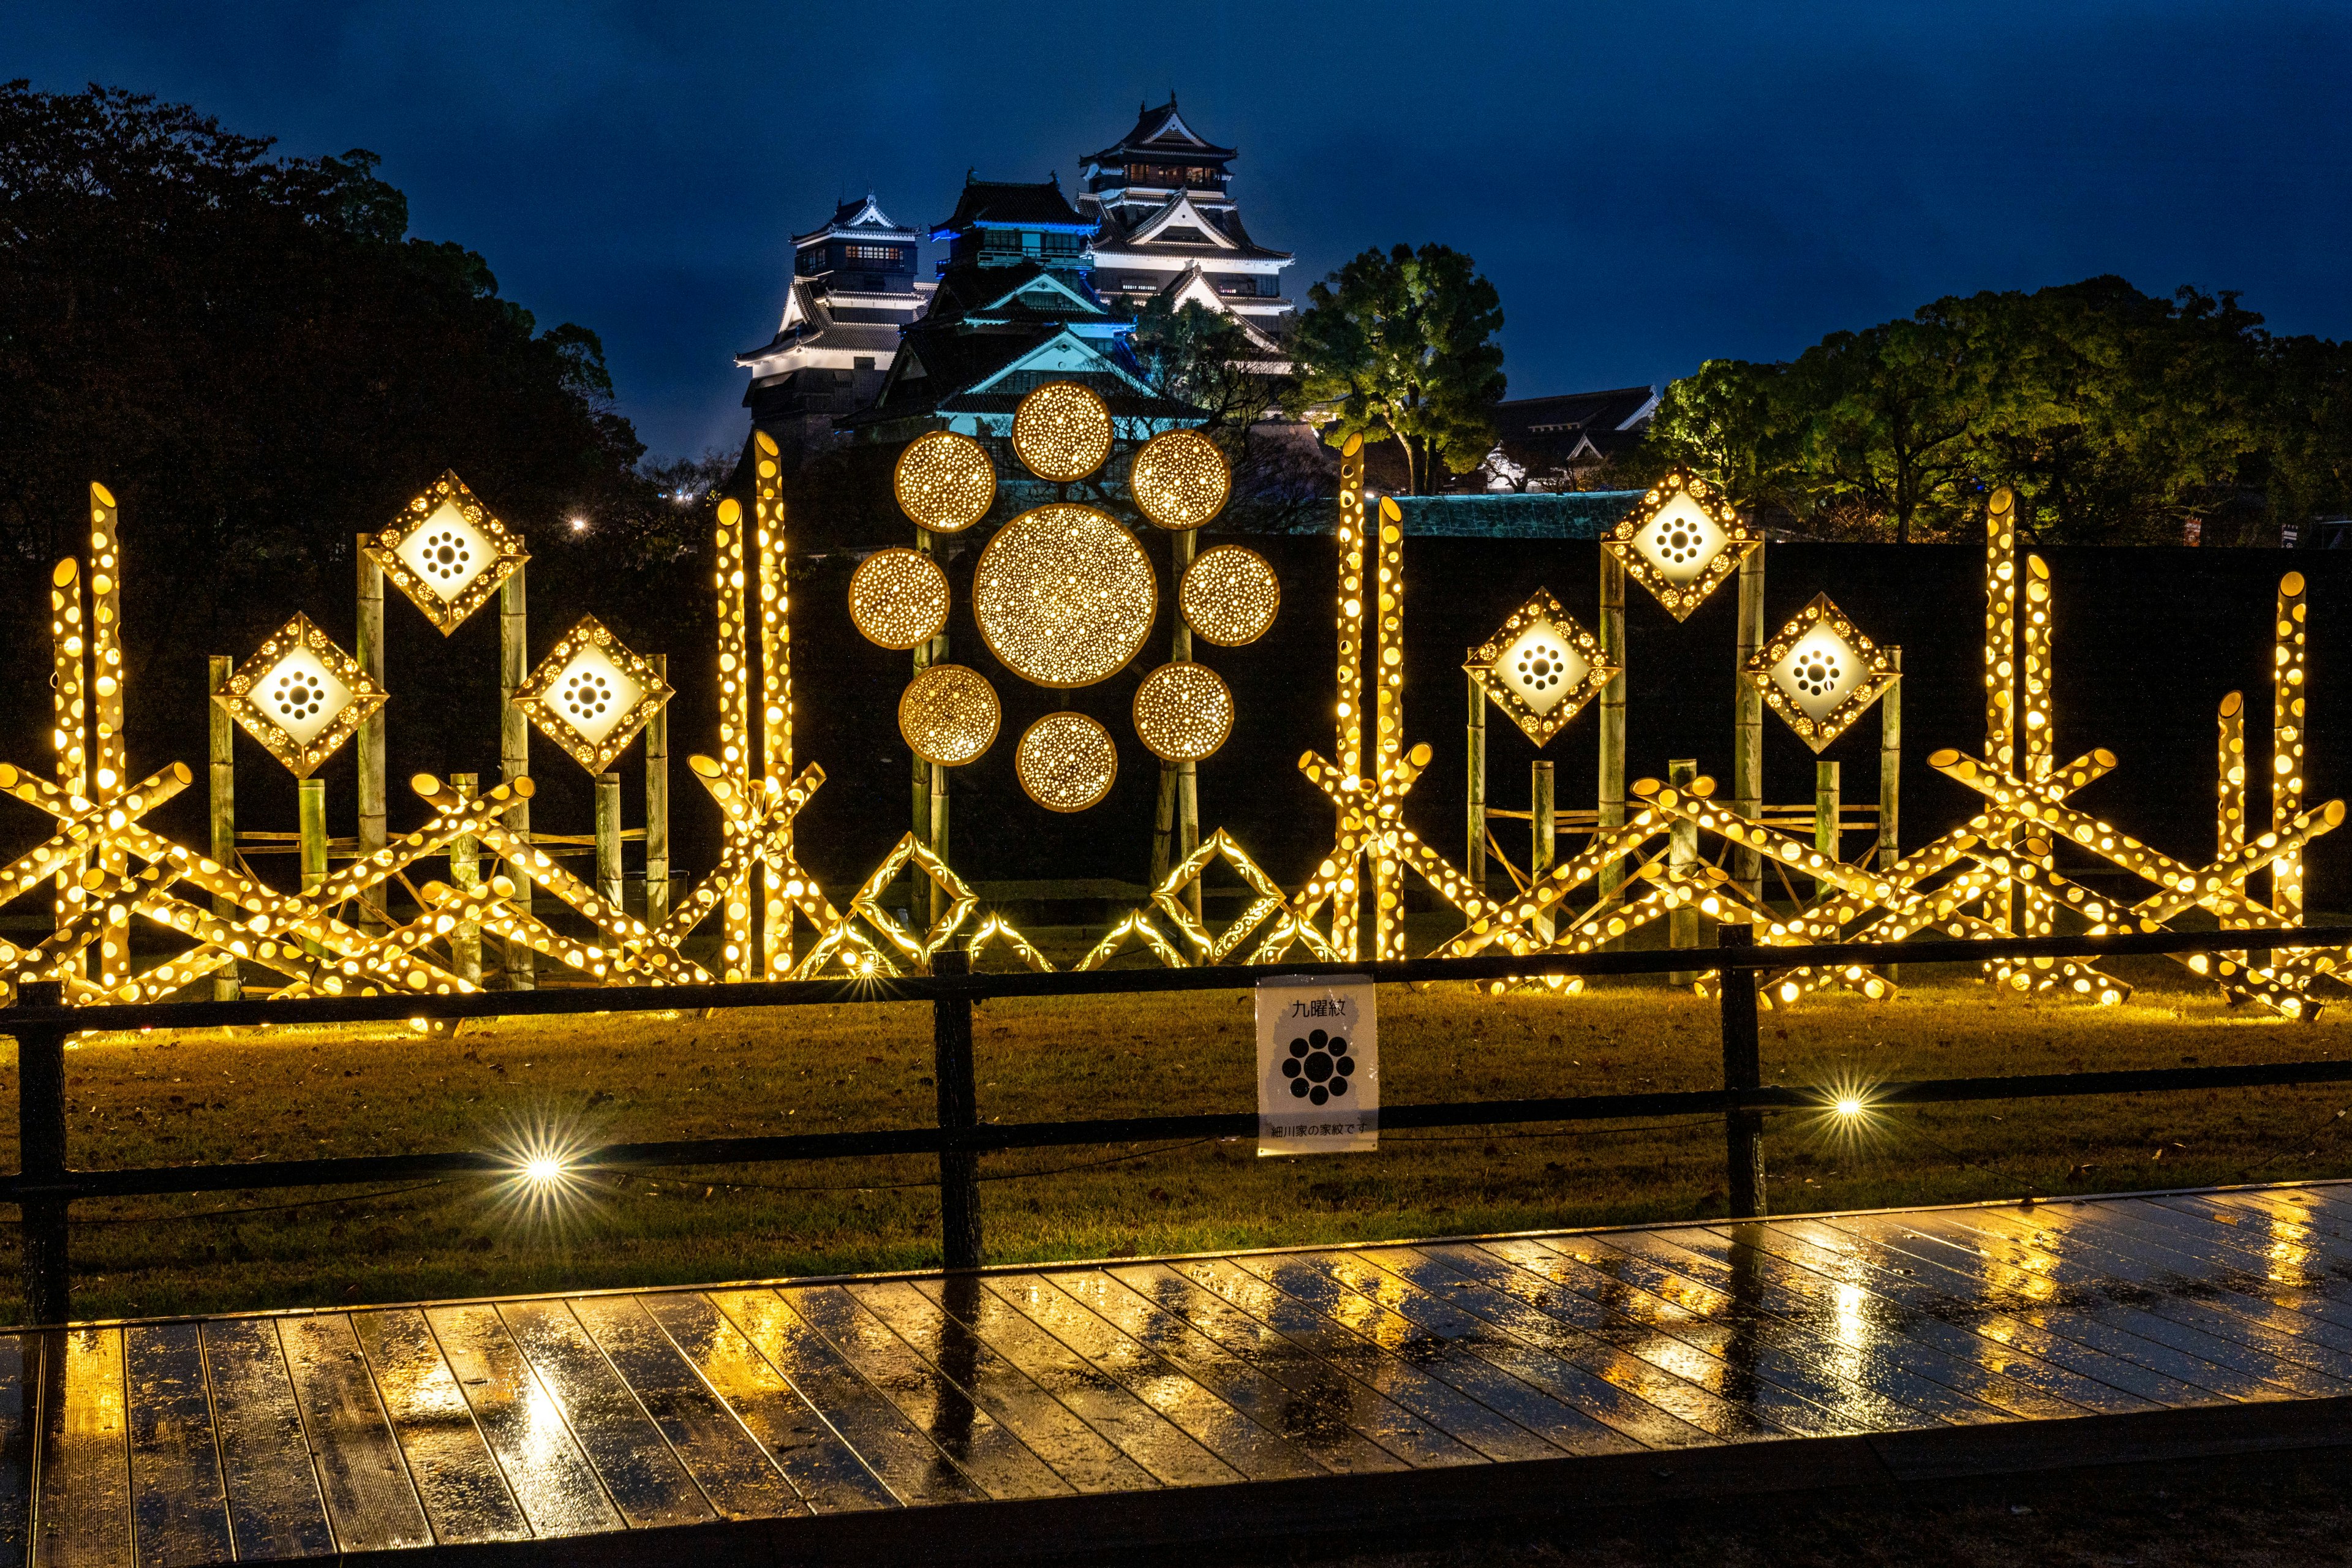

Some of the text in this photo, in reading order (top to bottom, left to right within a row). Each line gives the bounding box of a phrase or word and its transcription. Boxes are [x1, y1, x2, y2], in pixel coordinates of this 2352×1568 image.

[1292, 999, 1346, 1017] 九曜紋
[1271, 1123, 1366, 1138] 細川家の家紋です
